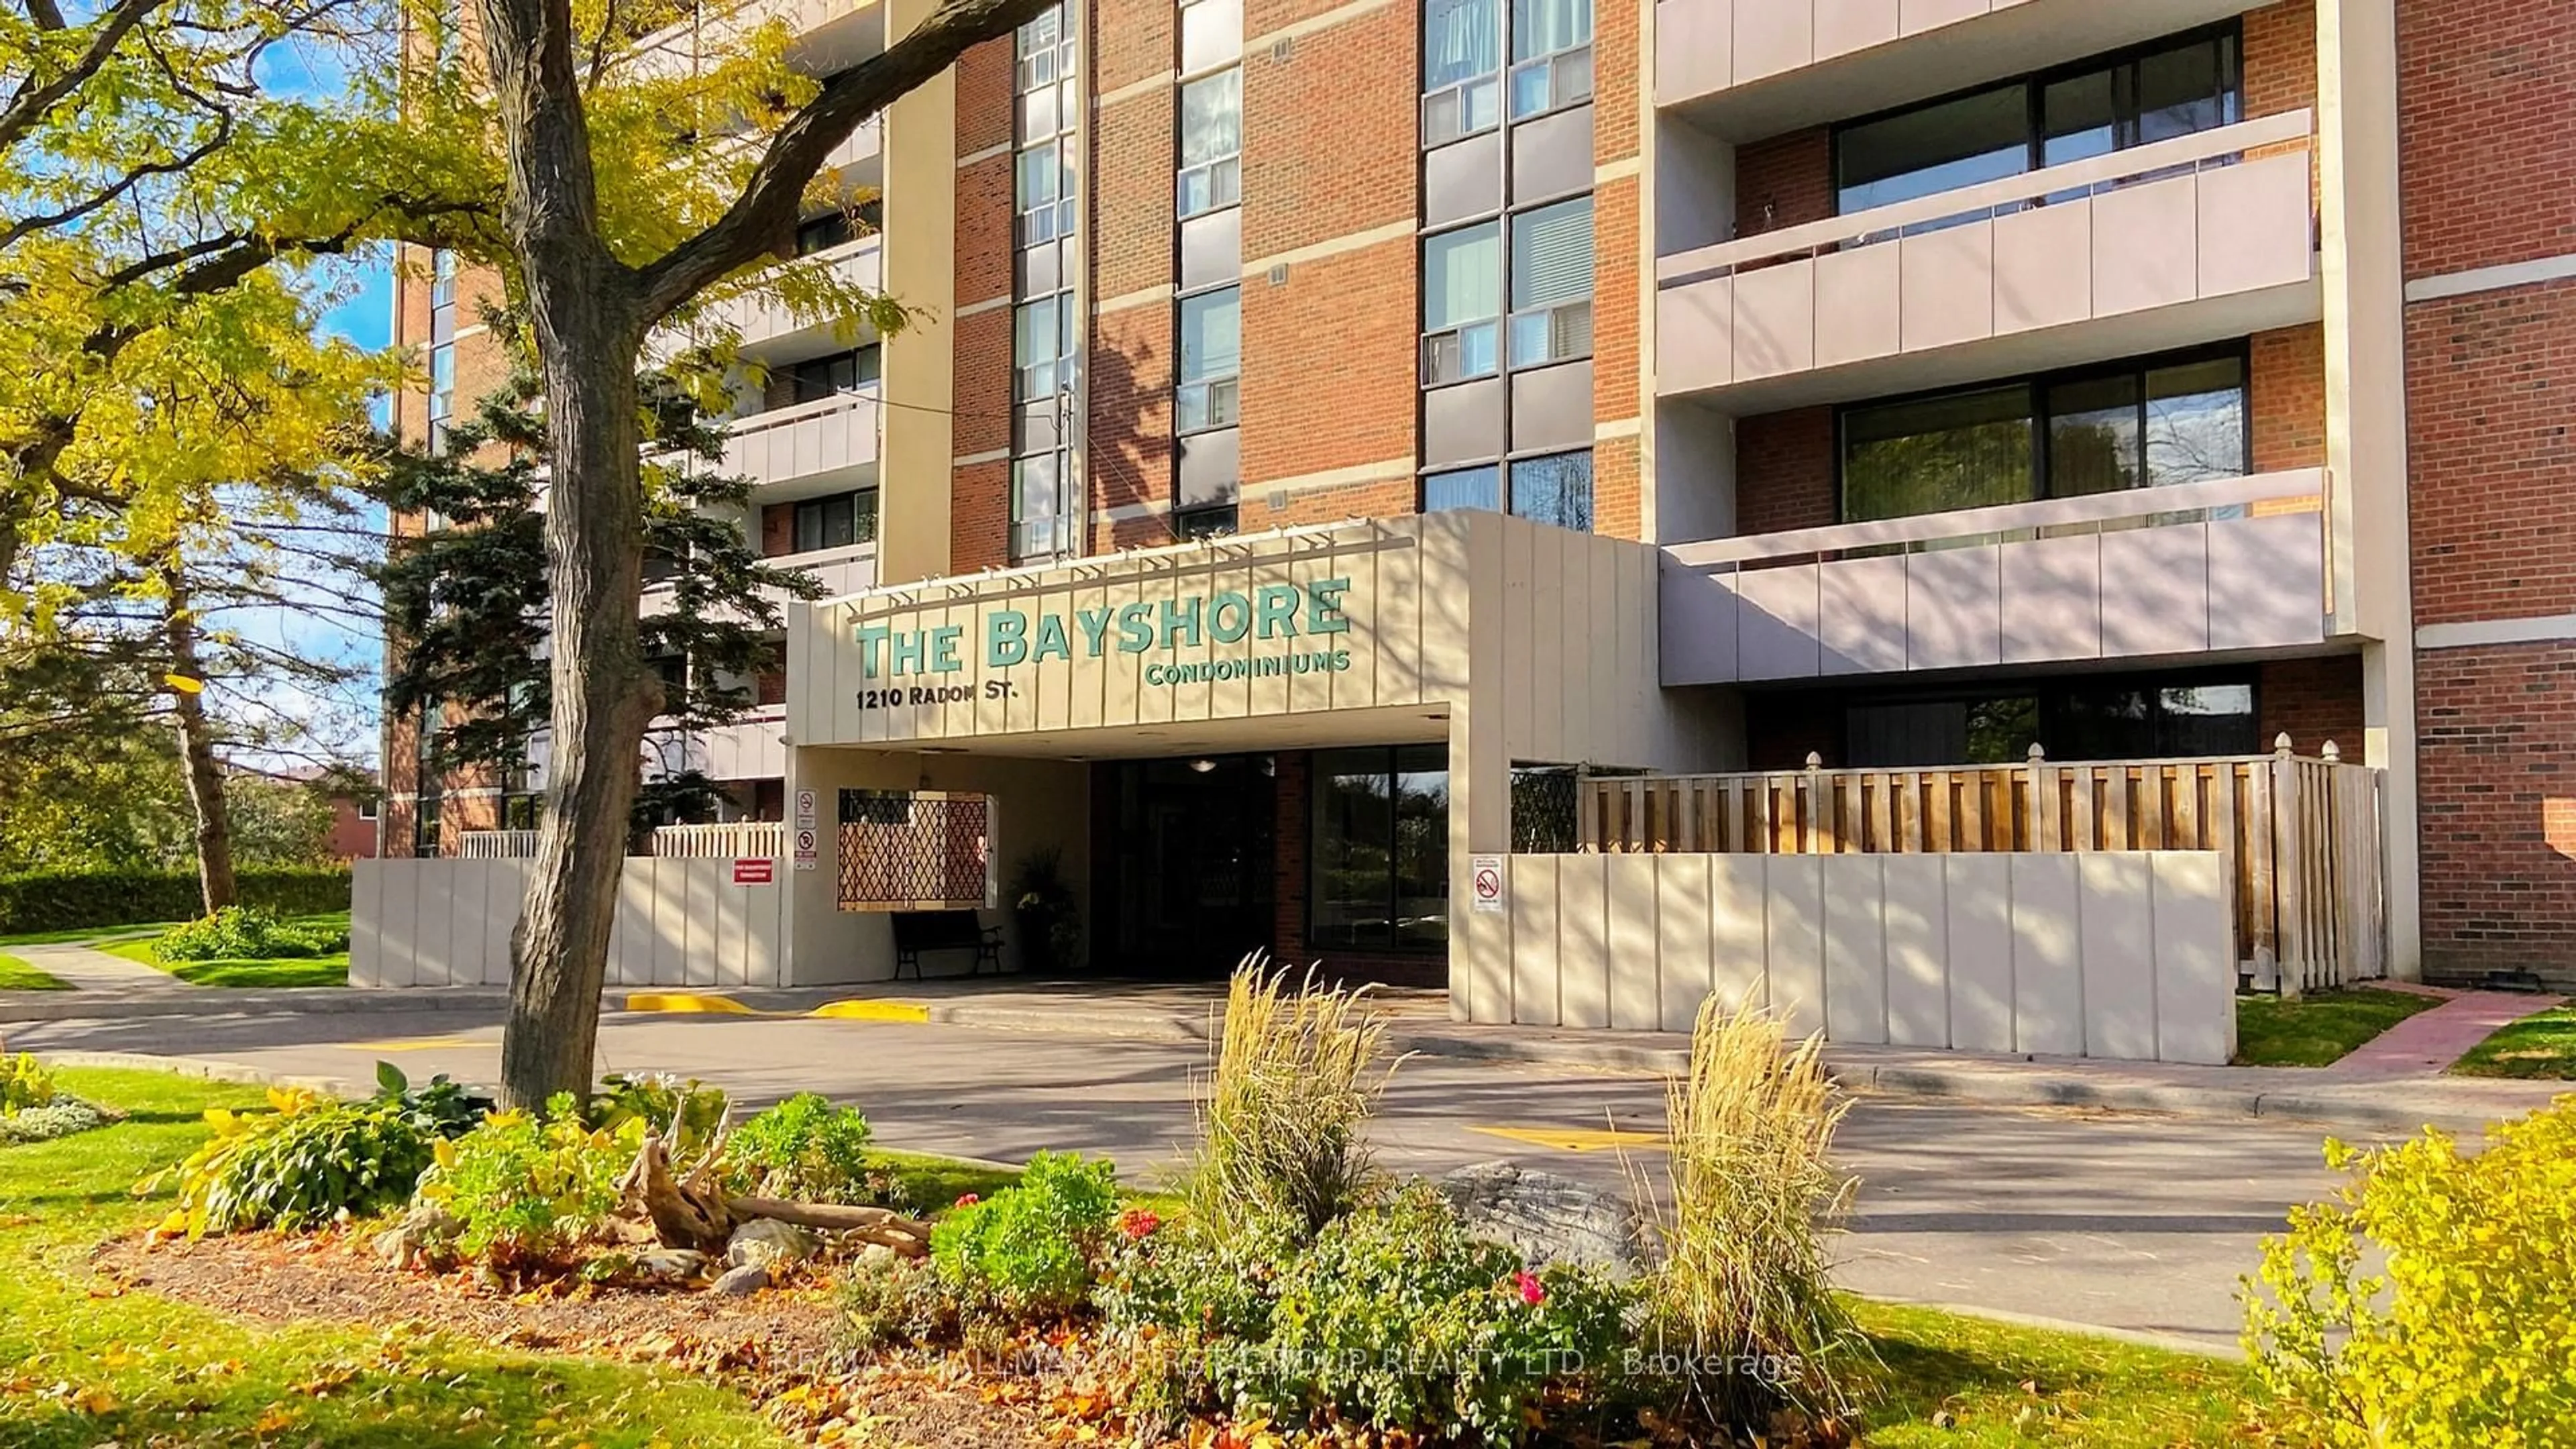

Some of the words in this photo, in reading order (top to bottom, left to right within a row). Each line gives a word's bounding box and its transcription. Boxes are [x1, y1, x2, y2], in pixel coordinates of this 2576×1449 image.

[856, 623, 963, 679] THE
[987, 579, 1350, 667] BAYSHORE
[1145, 650, 1350, 686] CONDOMINIUMS
[857, 688, 902, 710] 1210
[909, 684, 977, 705] RADOM
[985, 680, 1018, 700] ST.
